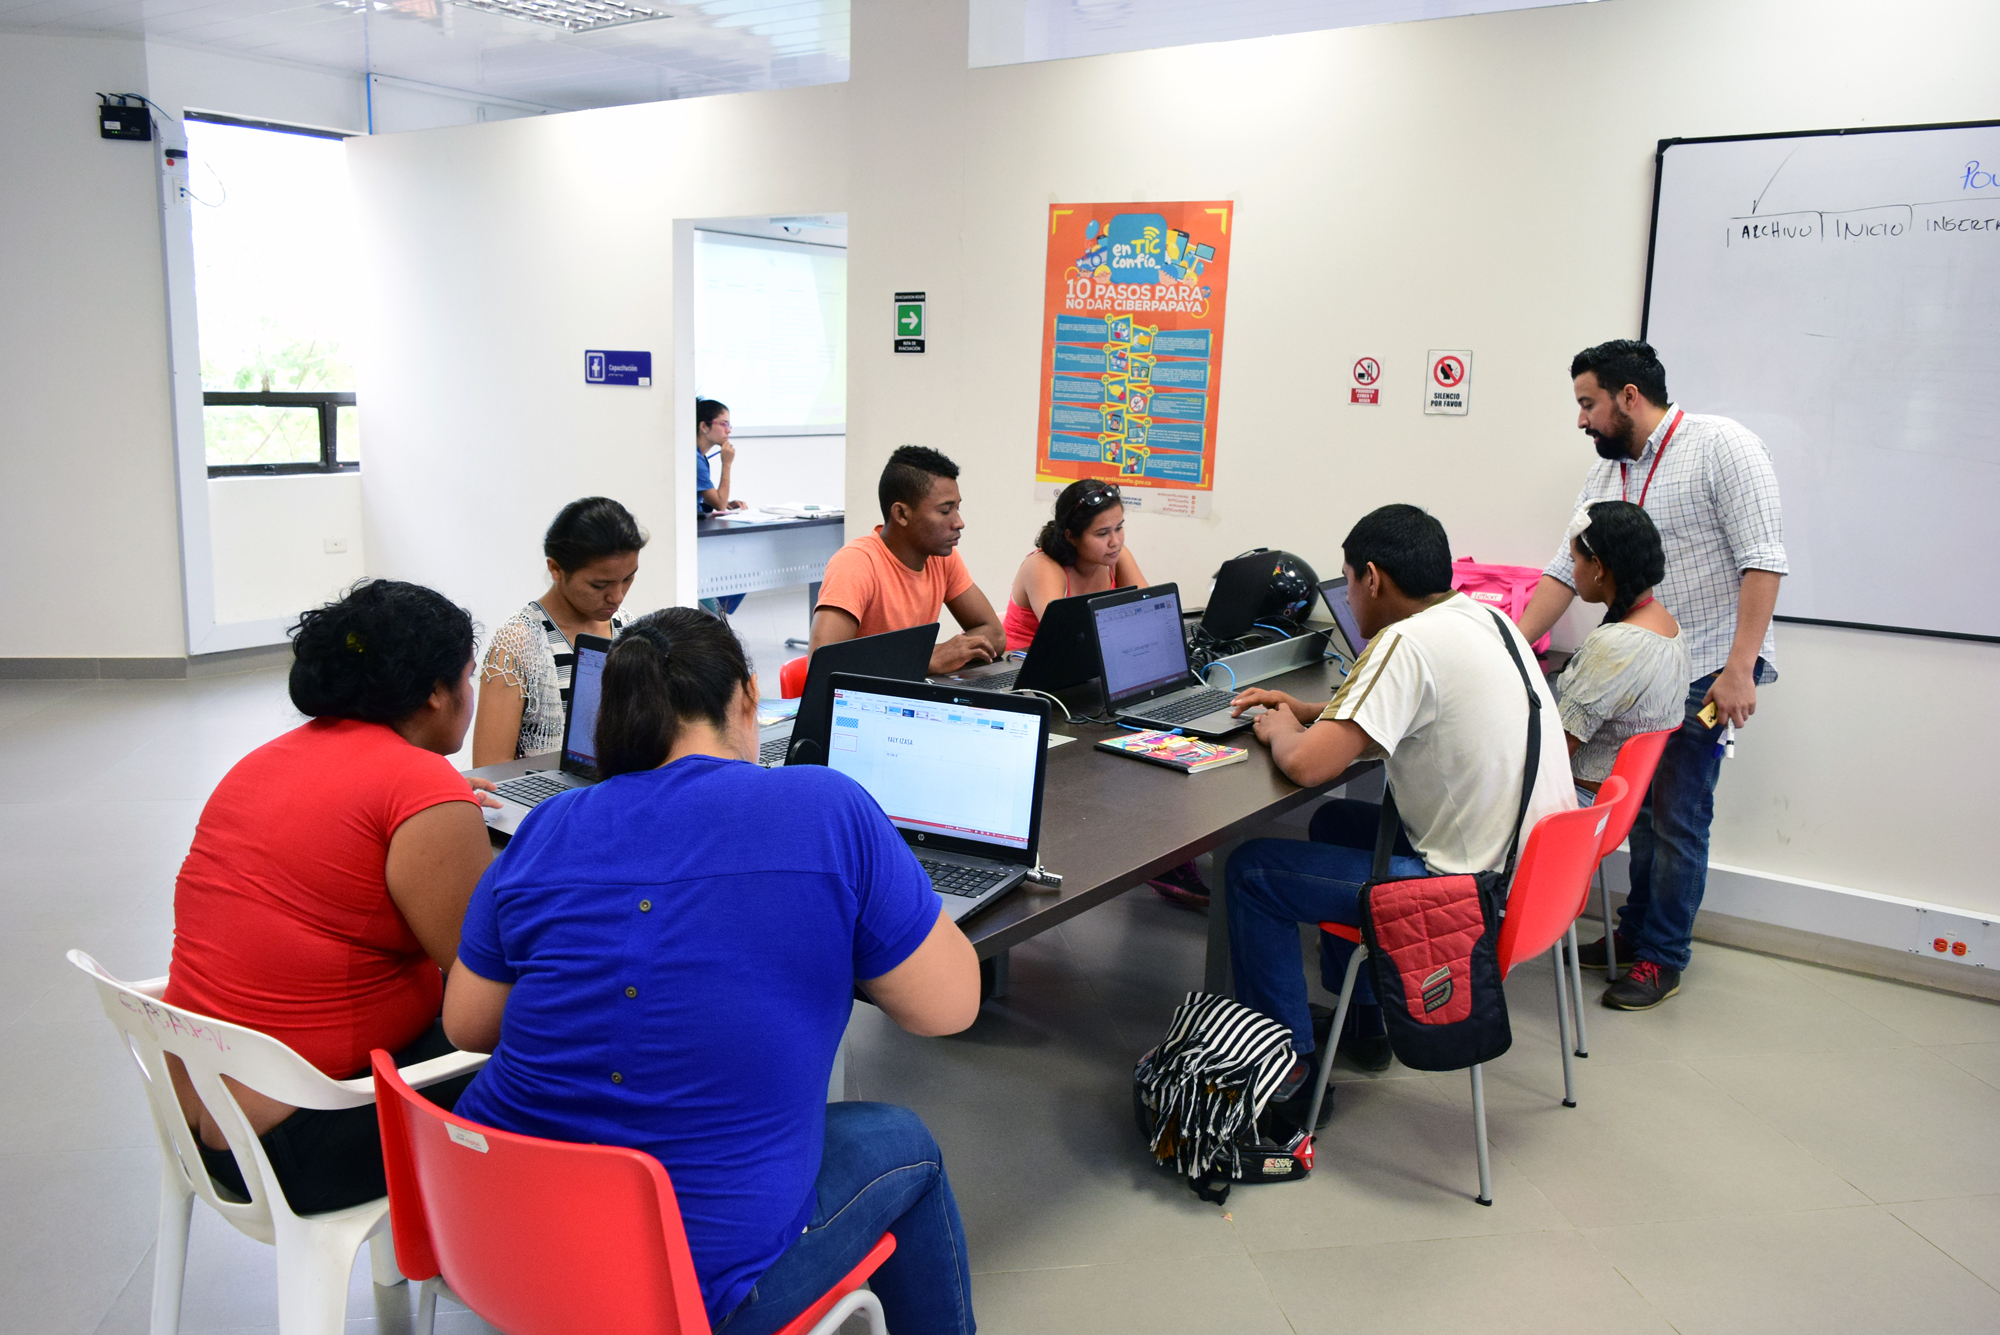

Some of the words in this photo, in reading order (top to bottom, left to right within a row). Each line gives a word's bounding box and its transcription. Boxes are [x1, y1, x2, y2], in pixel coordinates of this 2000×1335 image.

[1741, 220, 1812, 240] ARCHIVO
[1836, 219, 1904, 241] INICIO
[1112, 243, 1132, 257] en
[1130, 238, 1161, 255] TIC
[1066, 278, 1091, 299] 10
[1095, 284, 1151, 300] PASOS
[1155, 284, 1203, 302] PARA
[1066, 299, 1084, 310] NO
[1086, 299, 1112, 311] DAR
[1114, 299, 1203, 313] CIBERPAPAYA
[1434, 392, 1460, 400] SILENCIO
[1443, 400, 1463, 408] FAVOR
